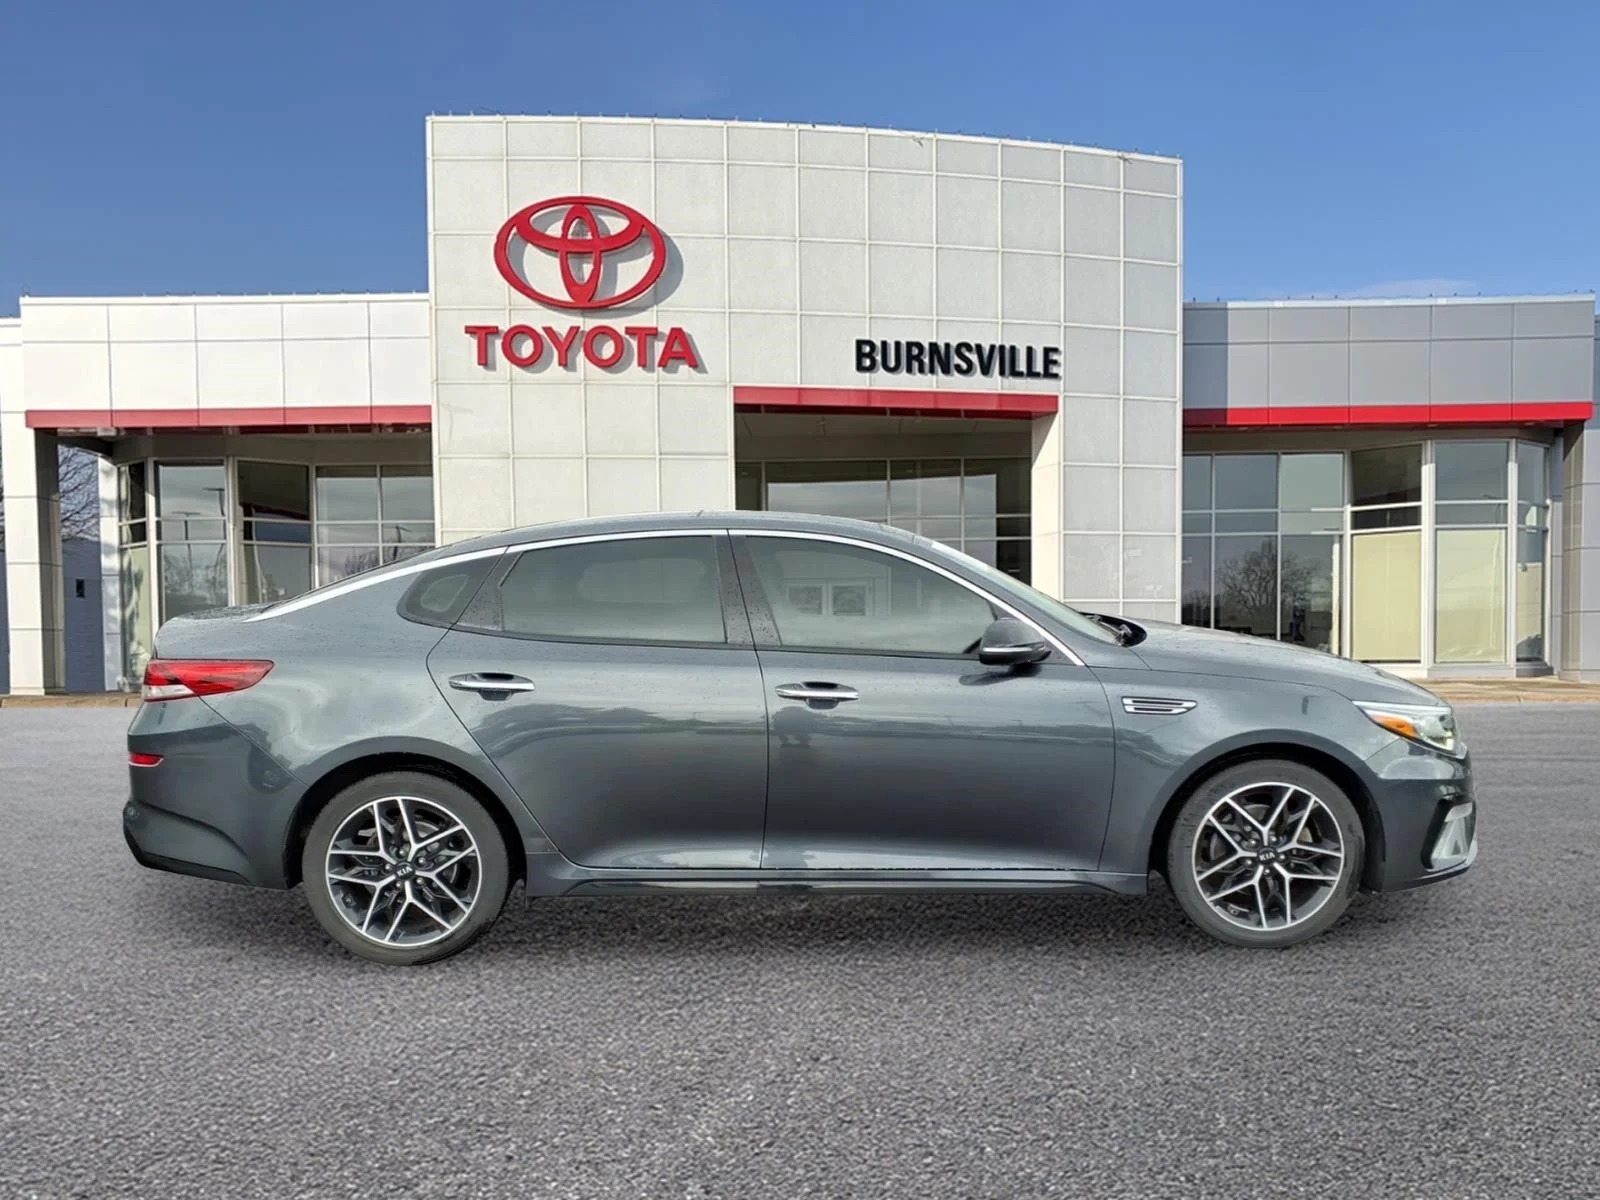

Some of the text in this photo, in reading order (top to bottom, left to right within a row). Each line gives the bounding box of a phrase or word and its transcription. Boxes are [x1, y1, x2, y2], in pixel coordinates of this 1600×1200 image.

[464, 324, 698, 368] TOYOTA
[855, 339, 1061, 379] BURNSVILLE
[1259, 851, 1275, 861] KIA
[396, 865, 413, 877] KIA
